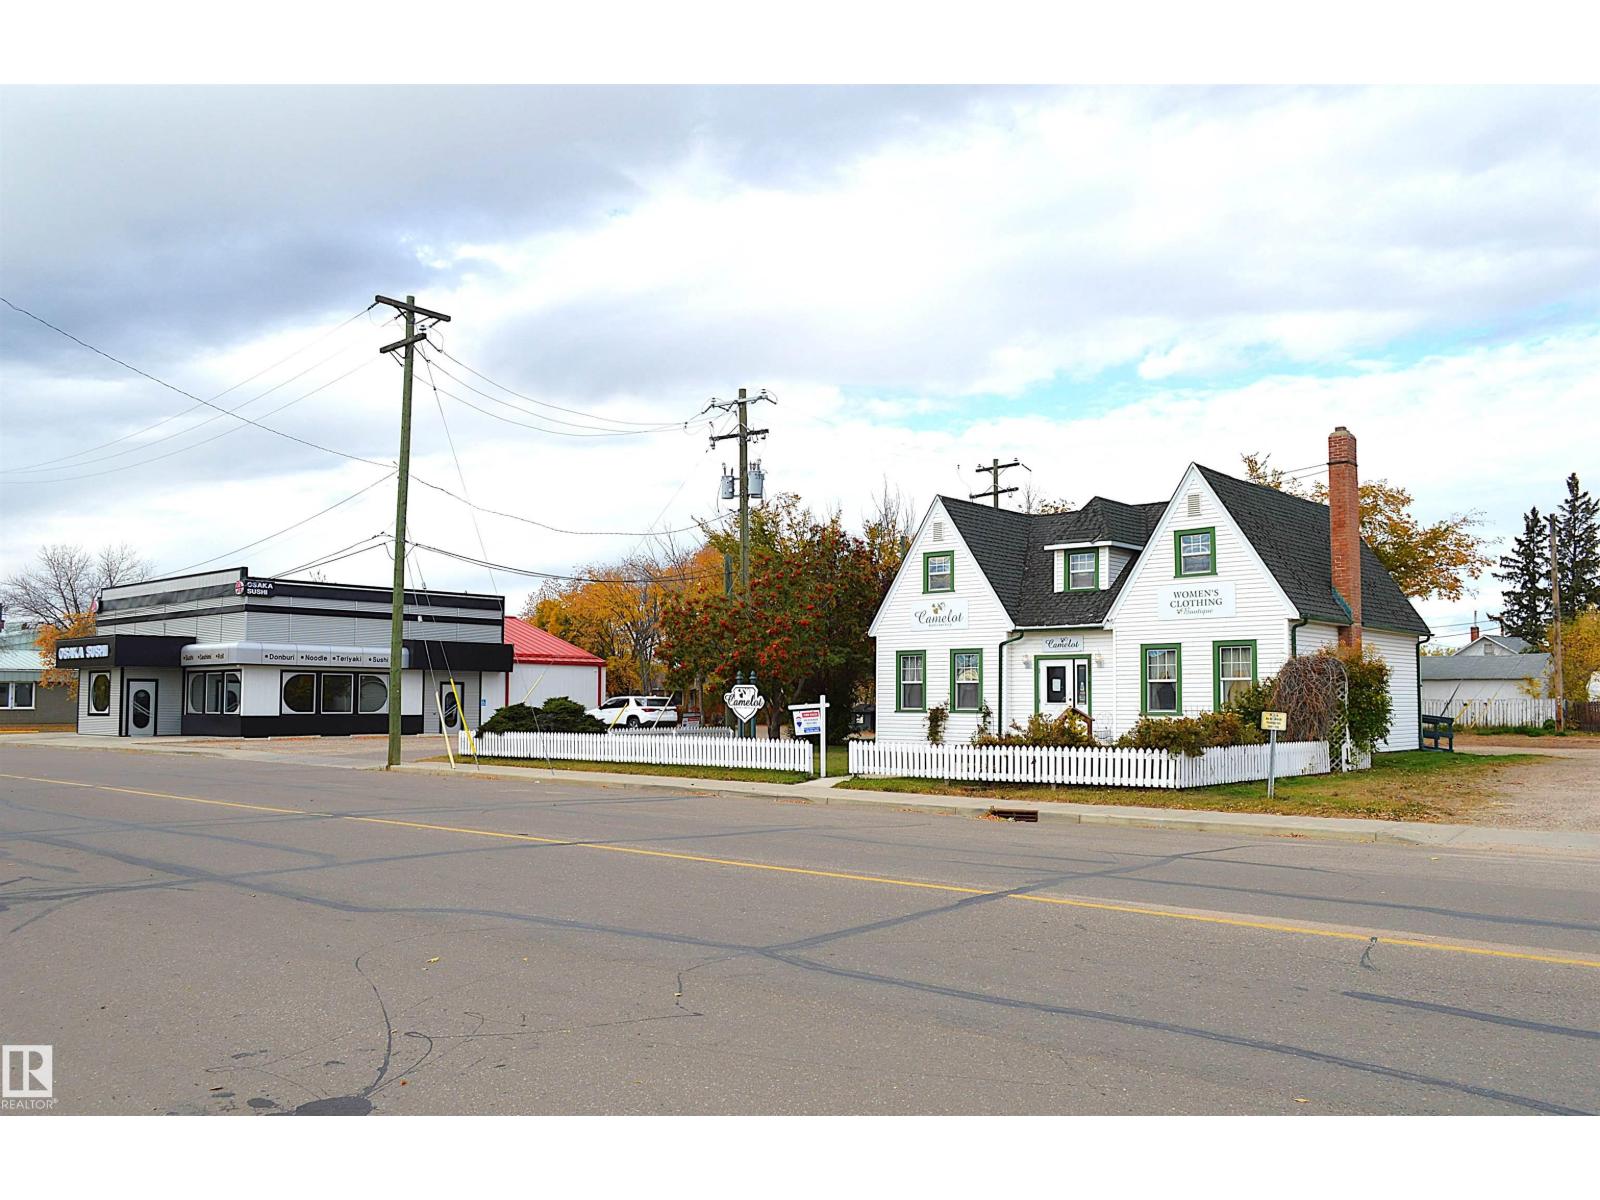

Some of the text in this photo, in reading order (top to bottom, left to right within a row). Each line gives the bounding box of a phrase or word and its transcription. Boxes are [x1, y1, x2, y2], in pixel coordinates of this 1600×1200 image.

[247, 581, 274, 589] OSAKA
[1173, 589, 1219, 599] WOMEN'S
[1169, 598, 1223, 608] CLOTHING
[914, 609, 963, 625] Camelot
[1045, 639, 1080, 649] Camelot
[725, 694, 763, 707] Camelot
